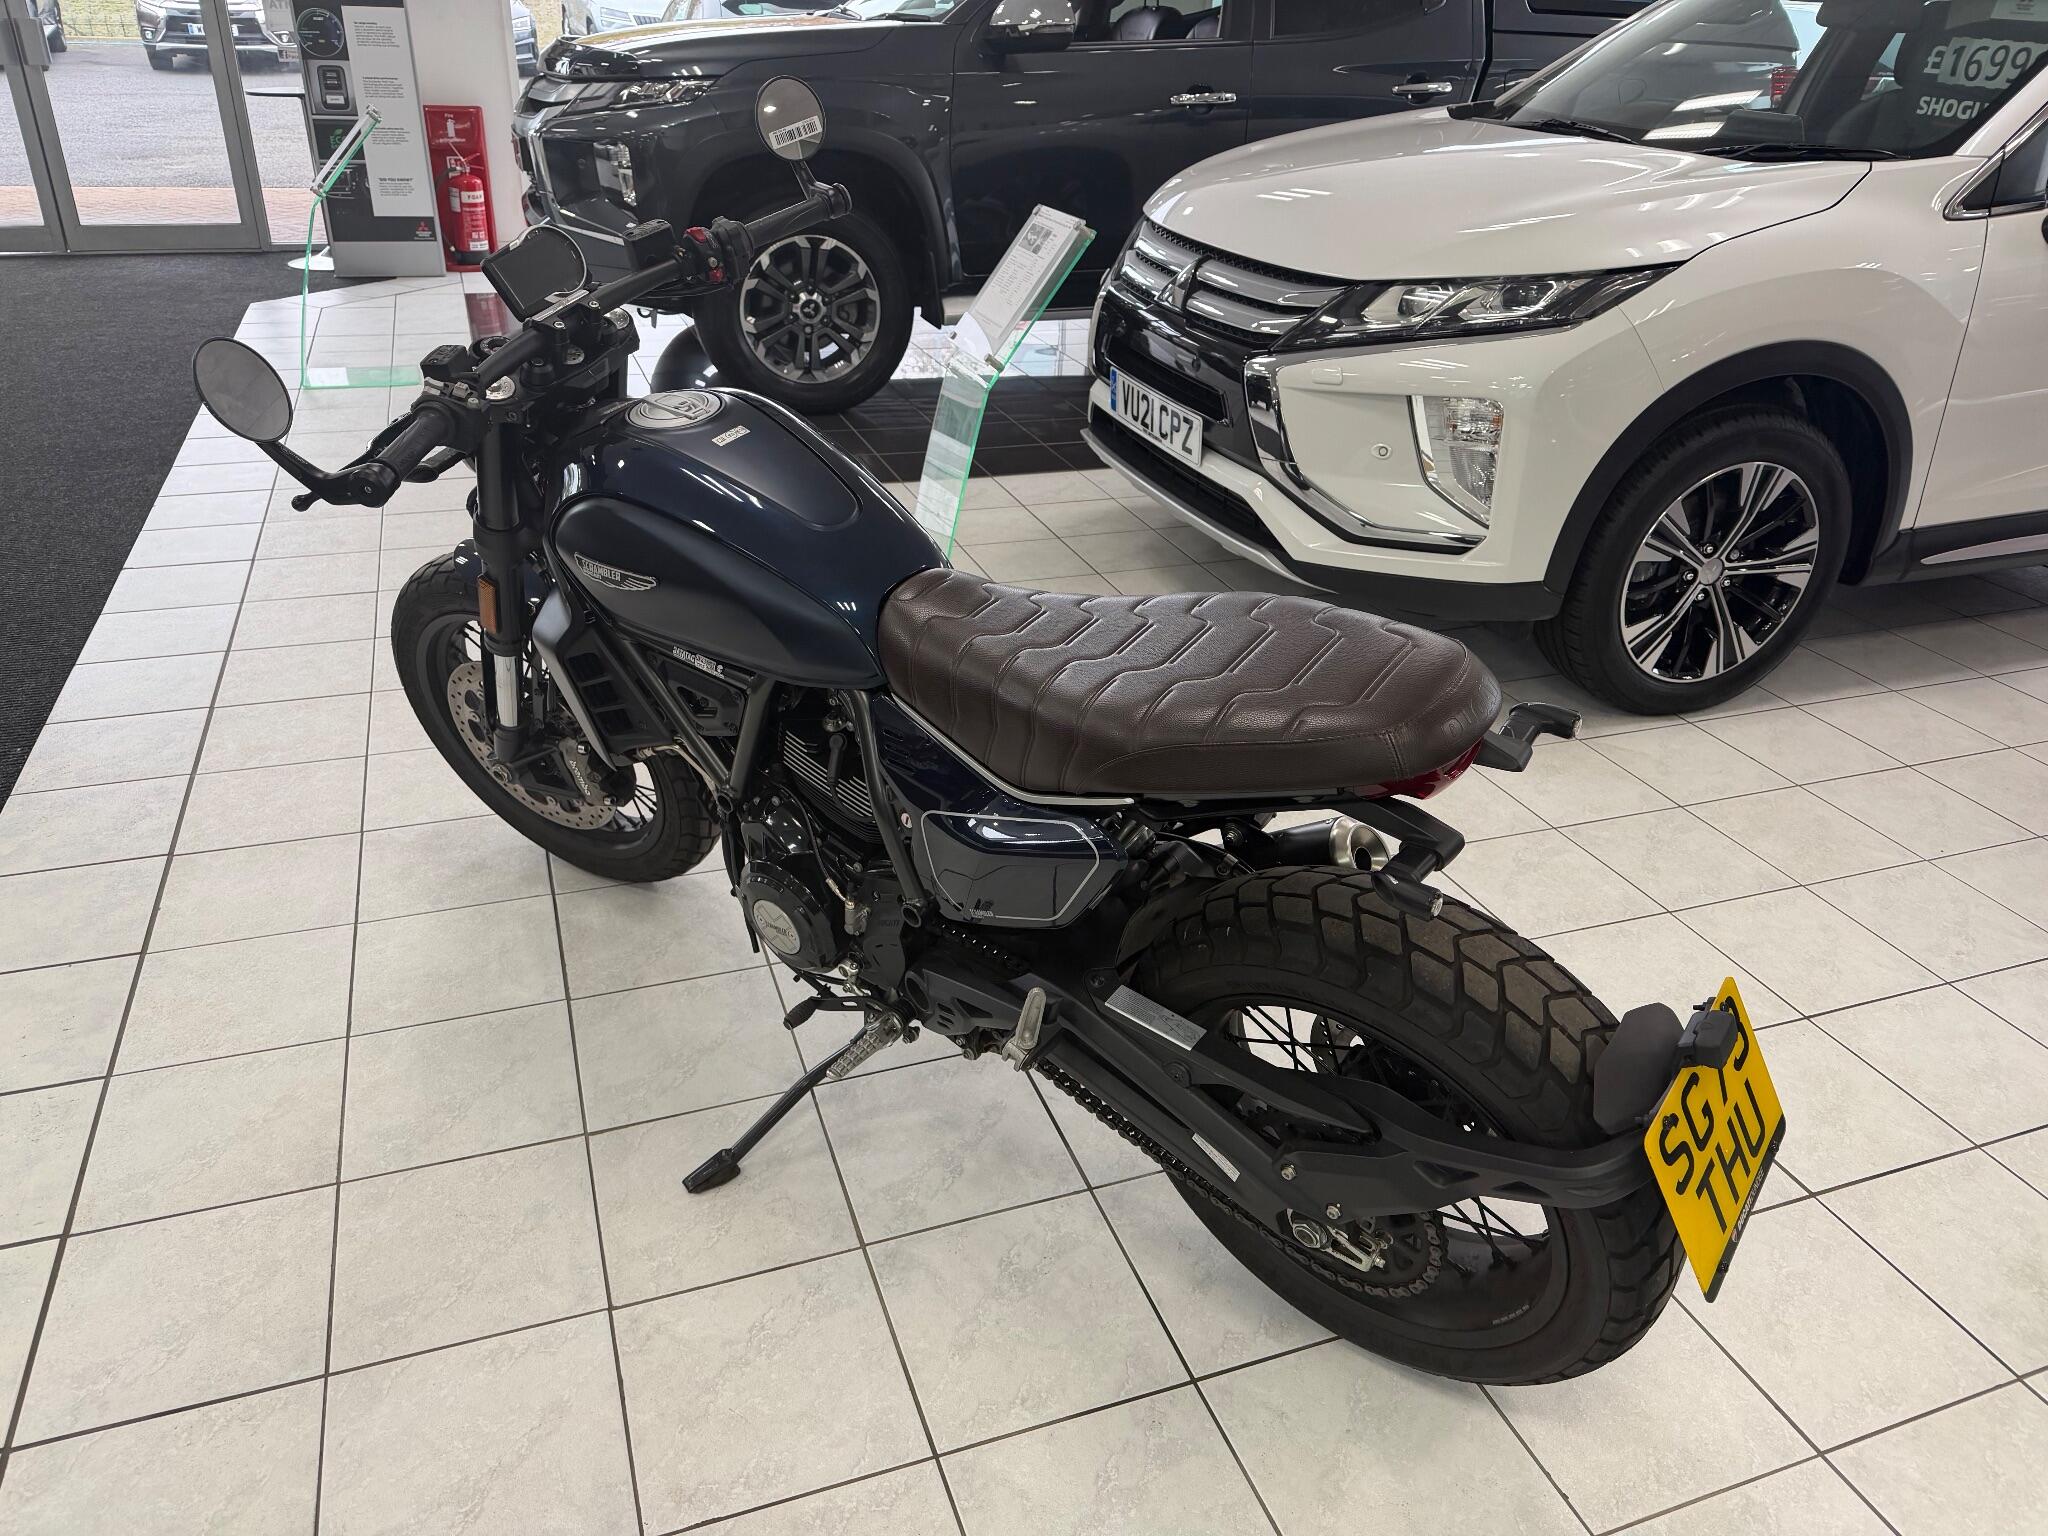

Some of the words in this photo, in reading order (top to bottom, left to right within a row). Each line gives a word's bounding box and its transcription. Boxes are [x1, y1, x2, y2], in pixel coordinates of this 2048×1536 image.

[1122, 380, 1154, 432] VU21
[1159, 404, 1194, 455] CPZ
[582, 559, 621, 581] SCRAMBLER
[1659, 996, 1749, 1195] SG3
[1696, 1078, 1766, 1234] THU
